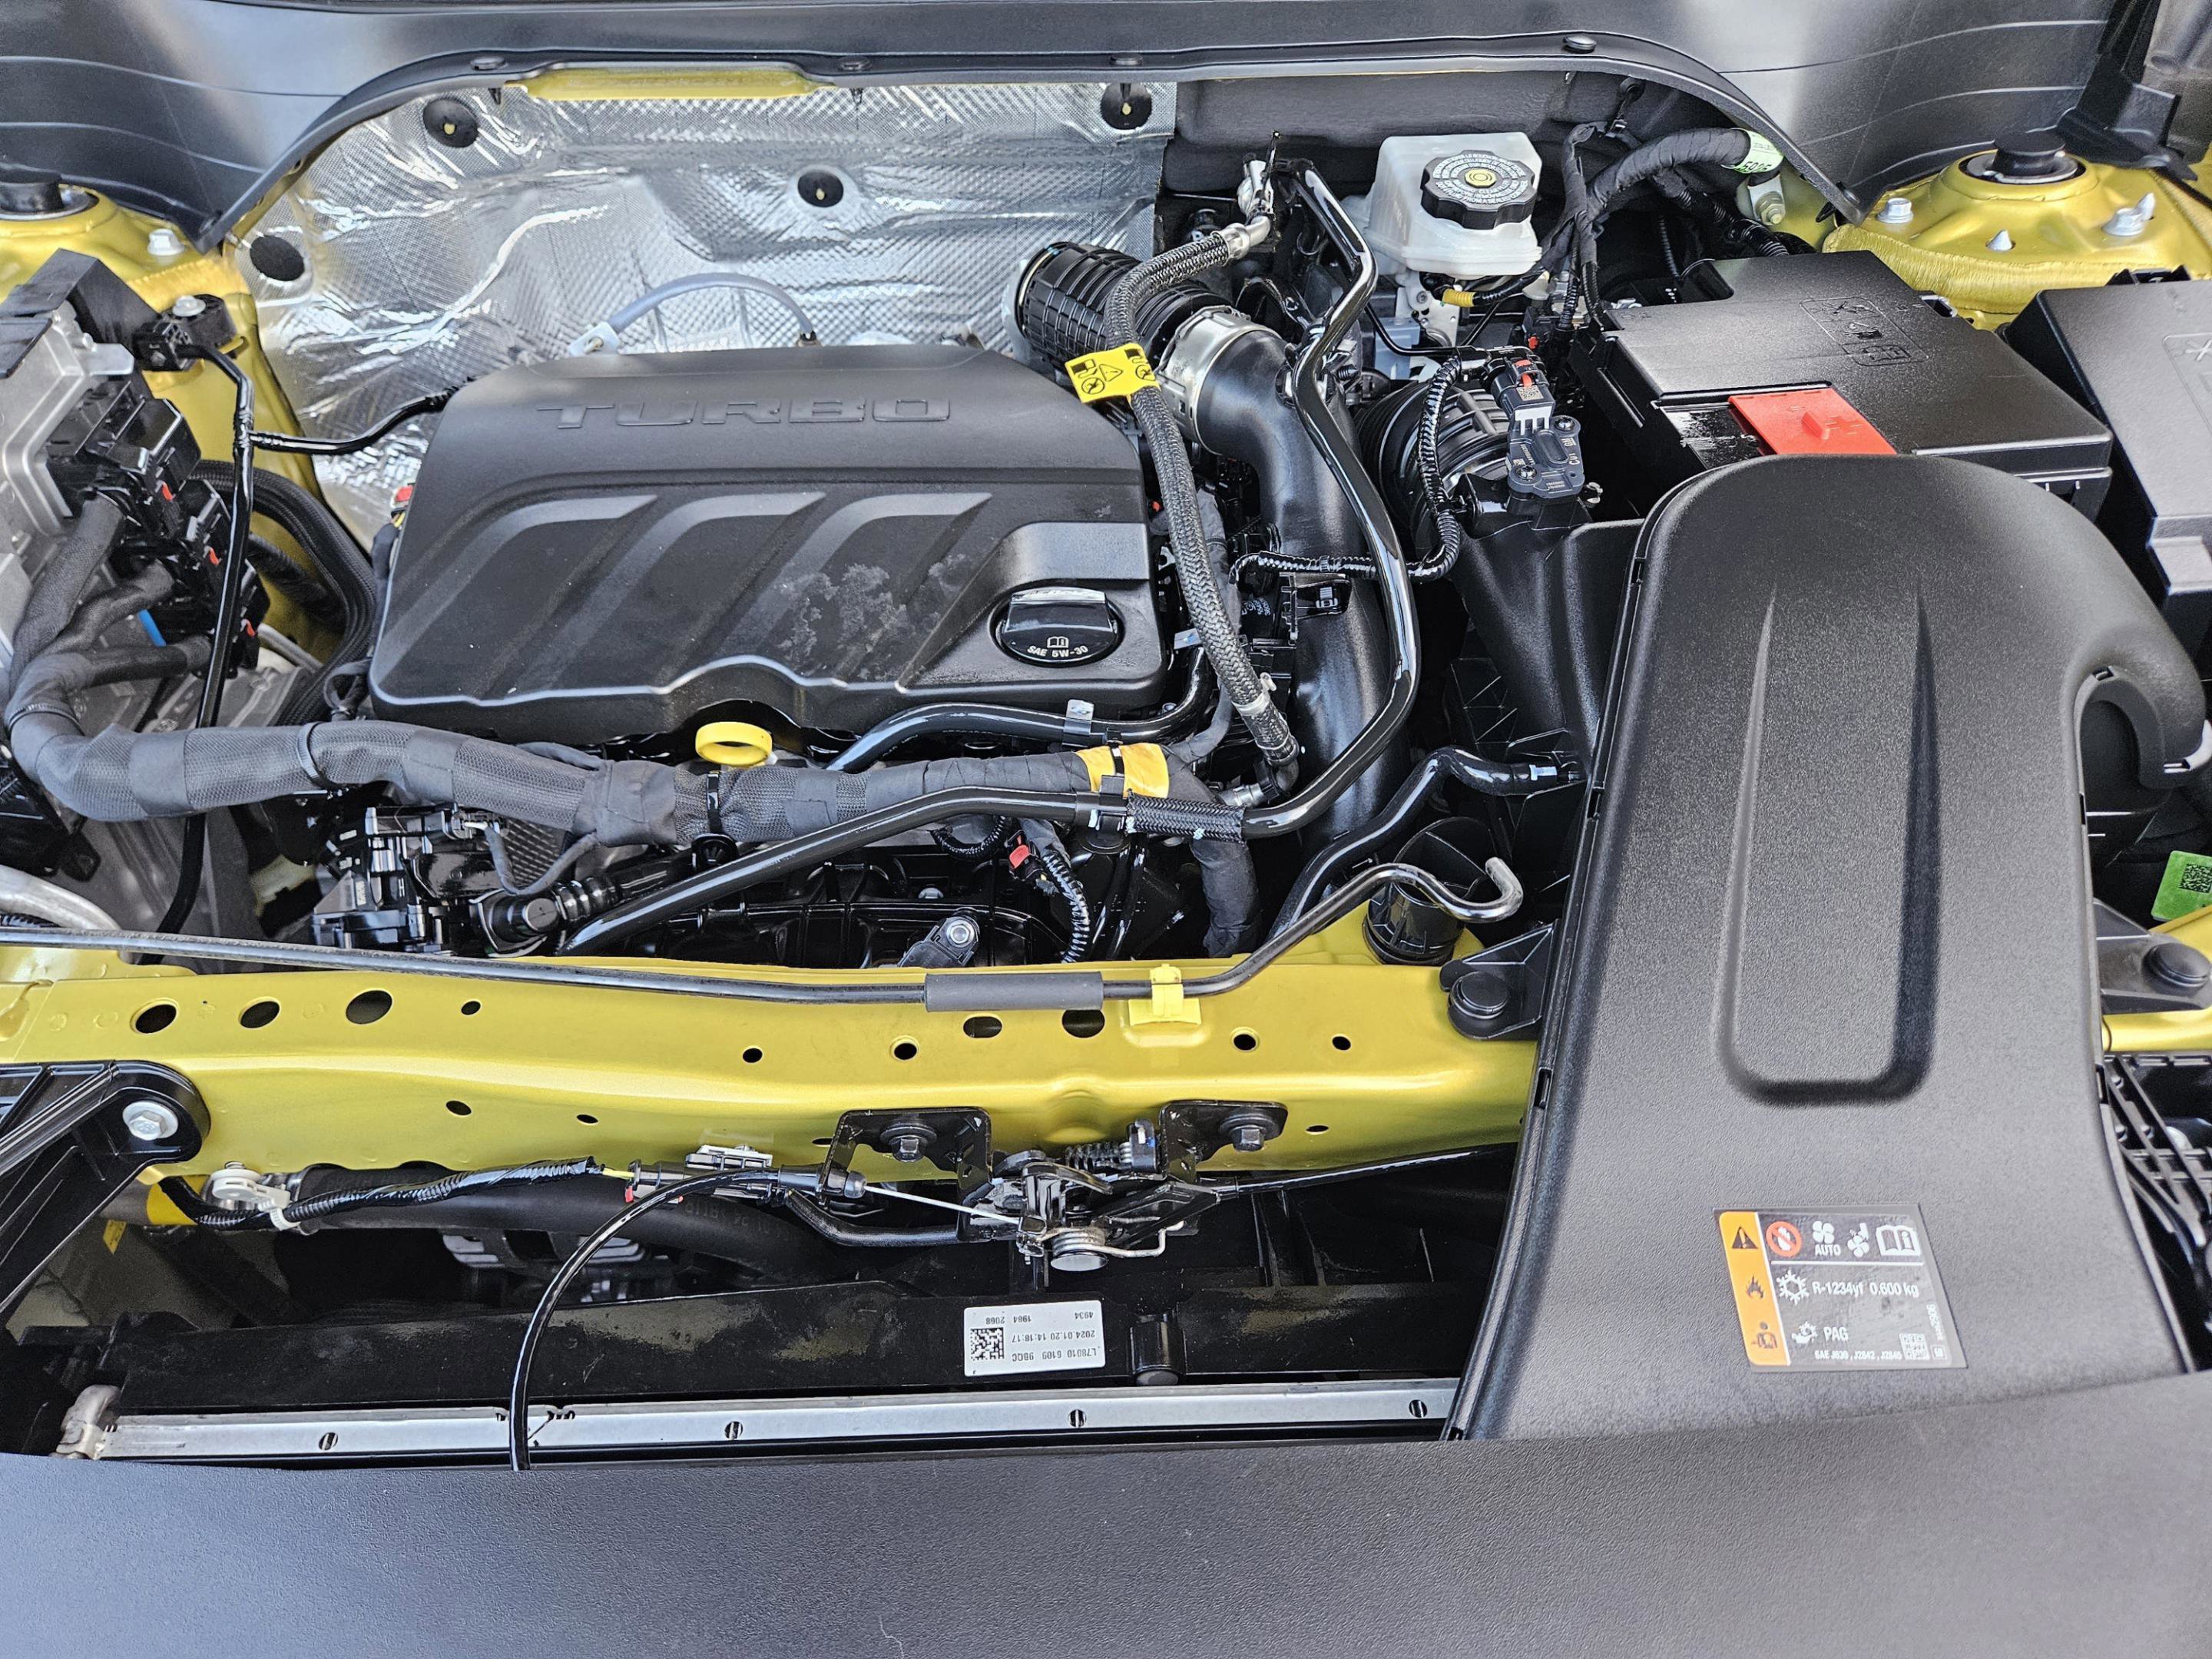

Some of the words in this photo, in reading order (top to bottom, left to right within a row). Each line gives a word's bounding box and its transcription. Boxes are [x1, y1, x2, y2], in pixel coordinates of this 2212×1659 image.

[536, 399, 952, 429] TURBO
[1027, 645, 1048, 657] SAE
[1051, 645, 1088, 657] 5W-30
[1815, 1244, 1841, 1256] AUTO
[1812, 1280, 1863, 1298] R-1234yf
[1869, 1282, 1902, 1296] 0.600
[1904, 1283, 1919, 1298] kg
[1075, 1311, 1094, 1320] 4934
[1012, 1333, 1046, 1343] 14:18:17
[1050, 1330, 1095, 1339] 2024.01.20
[1823, 1326, 1849, 1342] PAG
